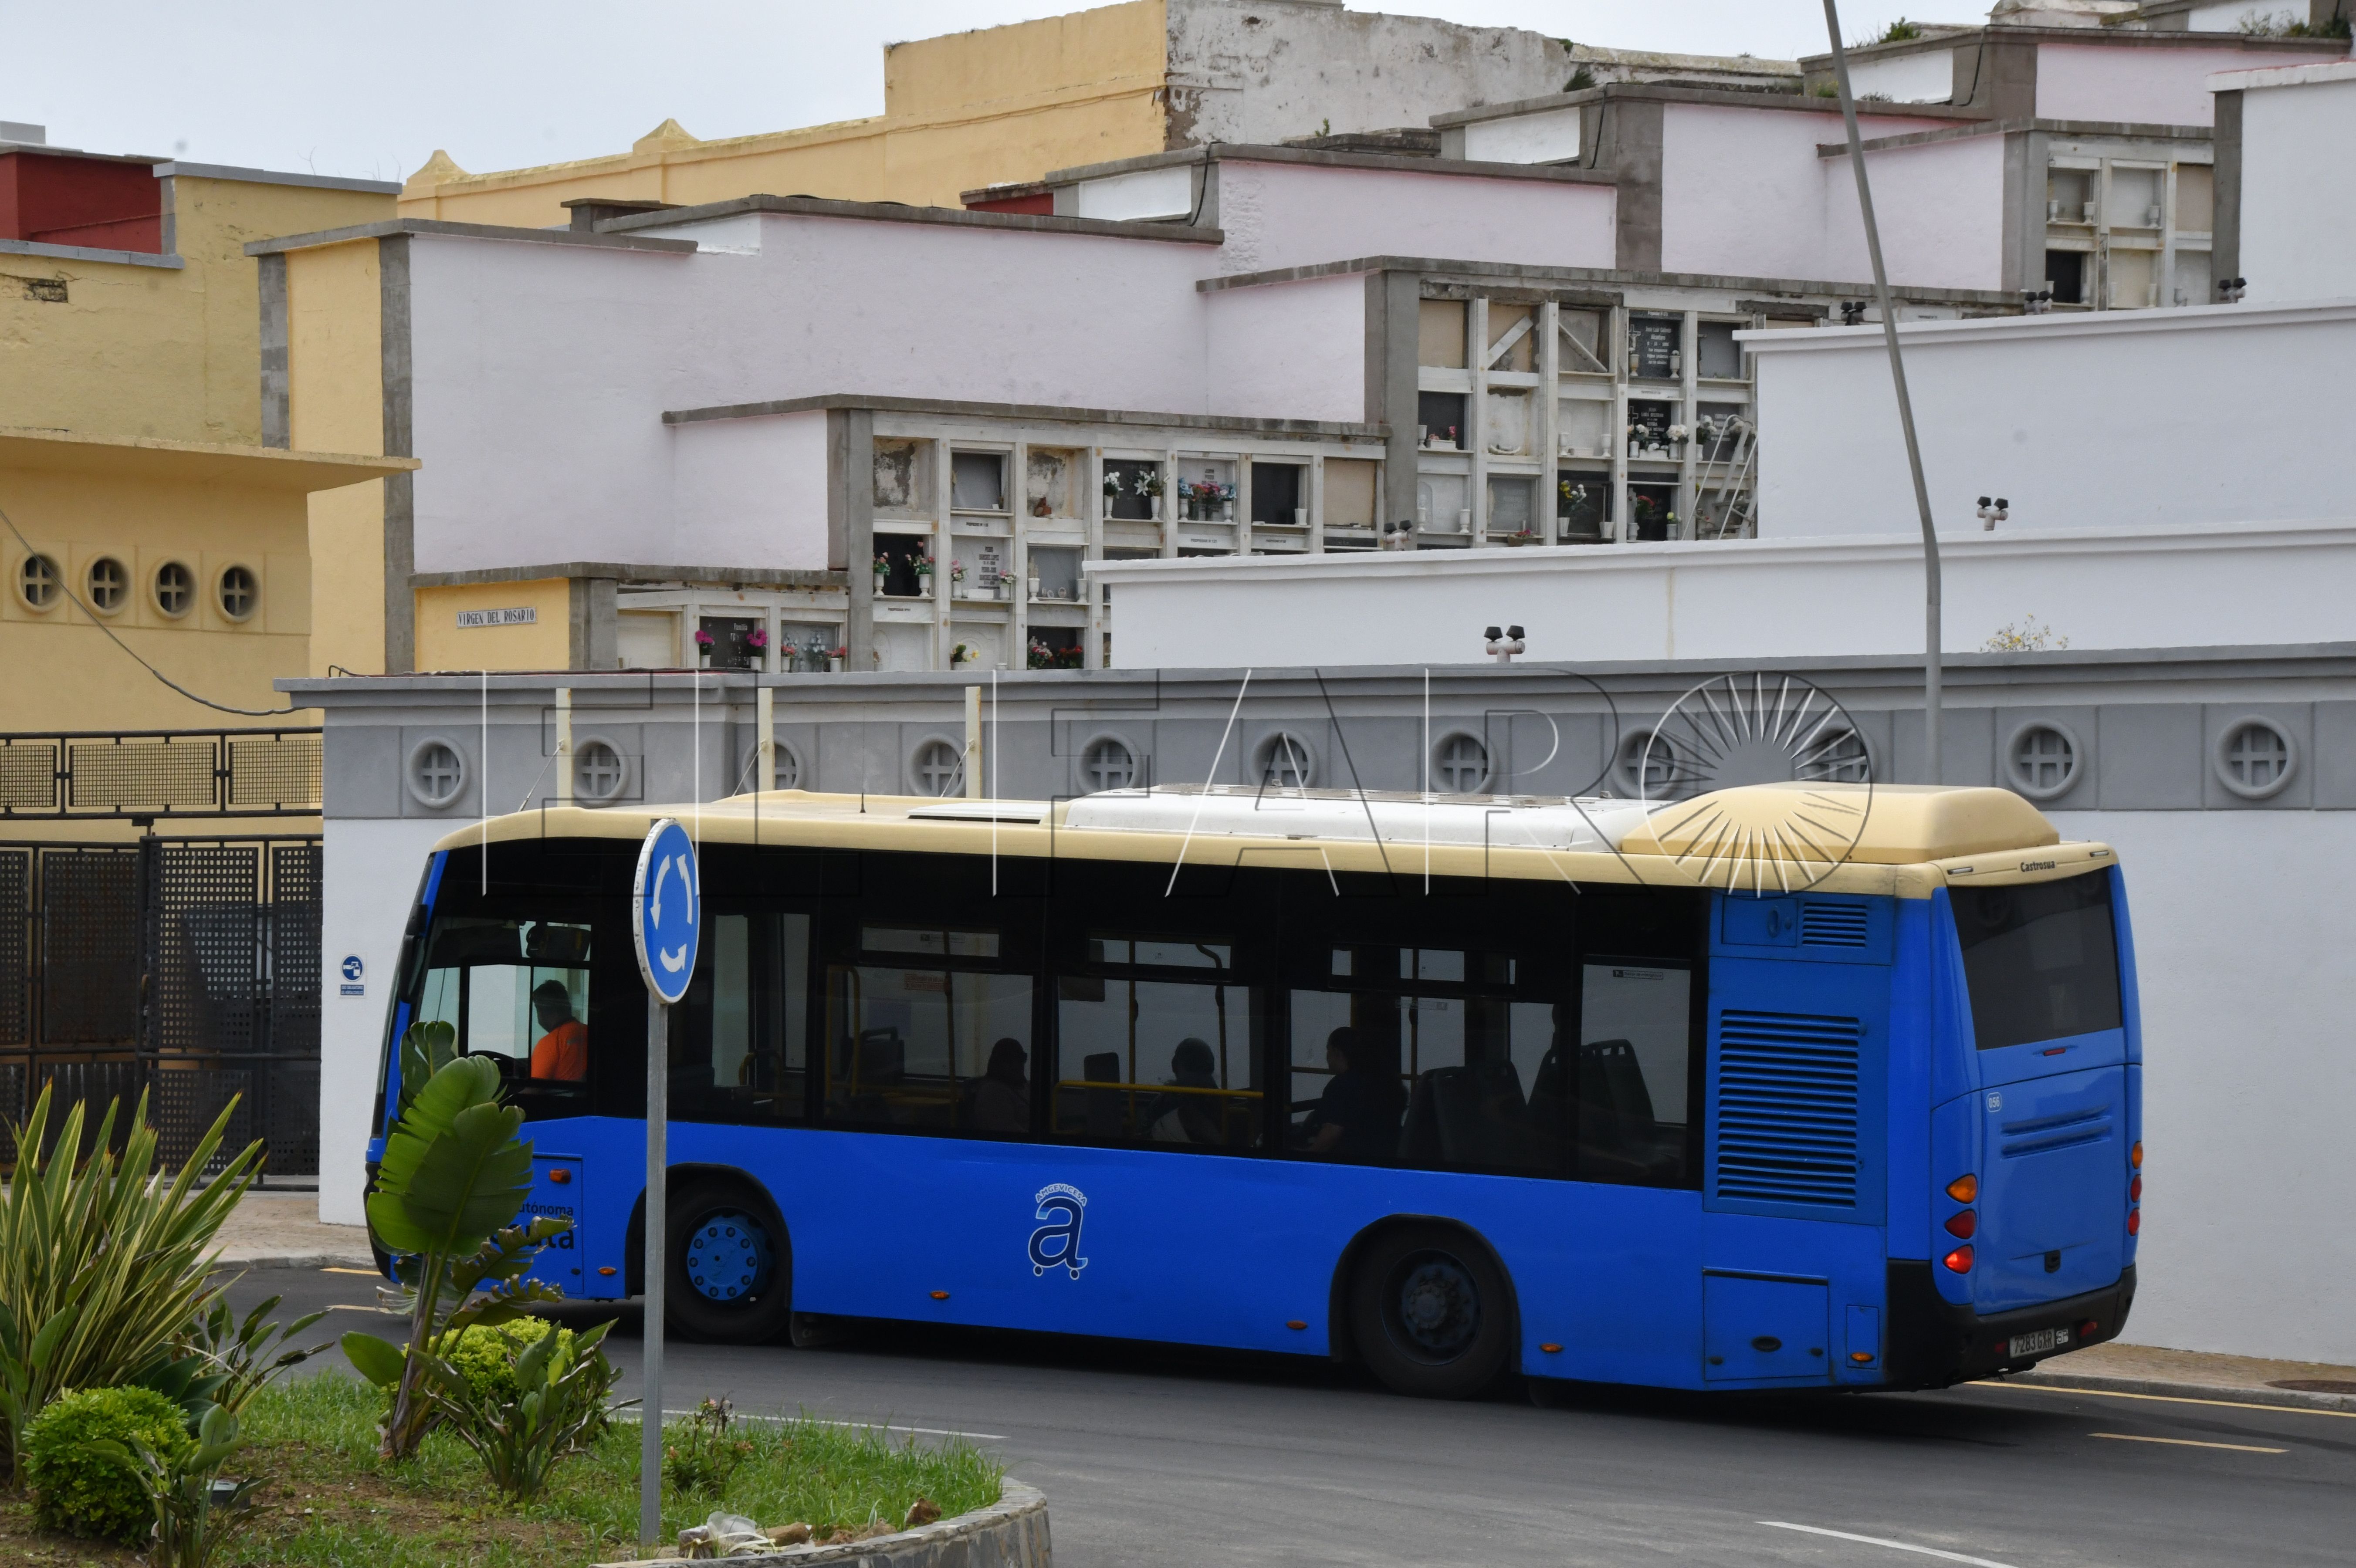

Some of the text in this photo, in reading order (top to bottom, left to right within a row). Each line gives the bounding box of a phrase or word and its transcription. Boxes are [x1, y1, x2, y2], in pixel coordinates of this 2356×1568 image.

[458, 609, 535, 625] VIRGEN DEL ROSARIO
[2020, 860, 2056, 872] Castrosua
[1988, 1096, 2001, 1108] 056
[1036, 1183, 1087, 1207] AMGEVICESA
[518, 1201, 574, 1216] utónoma
[2014, 1331, 2053, 1354] 7283 GXR
